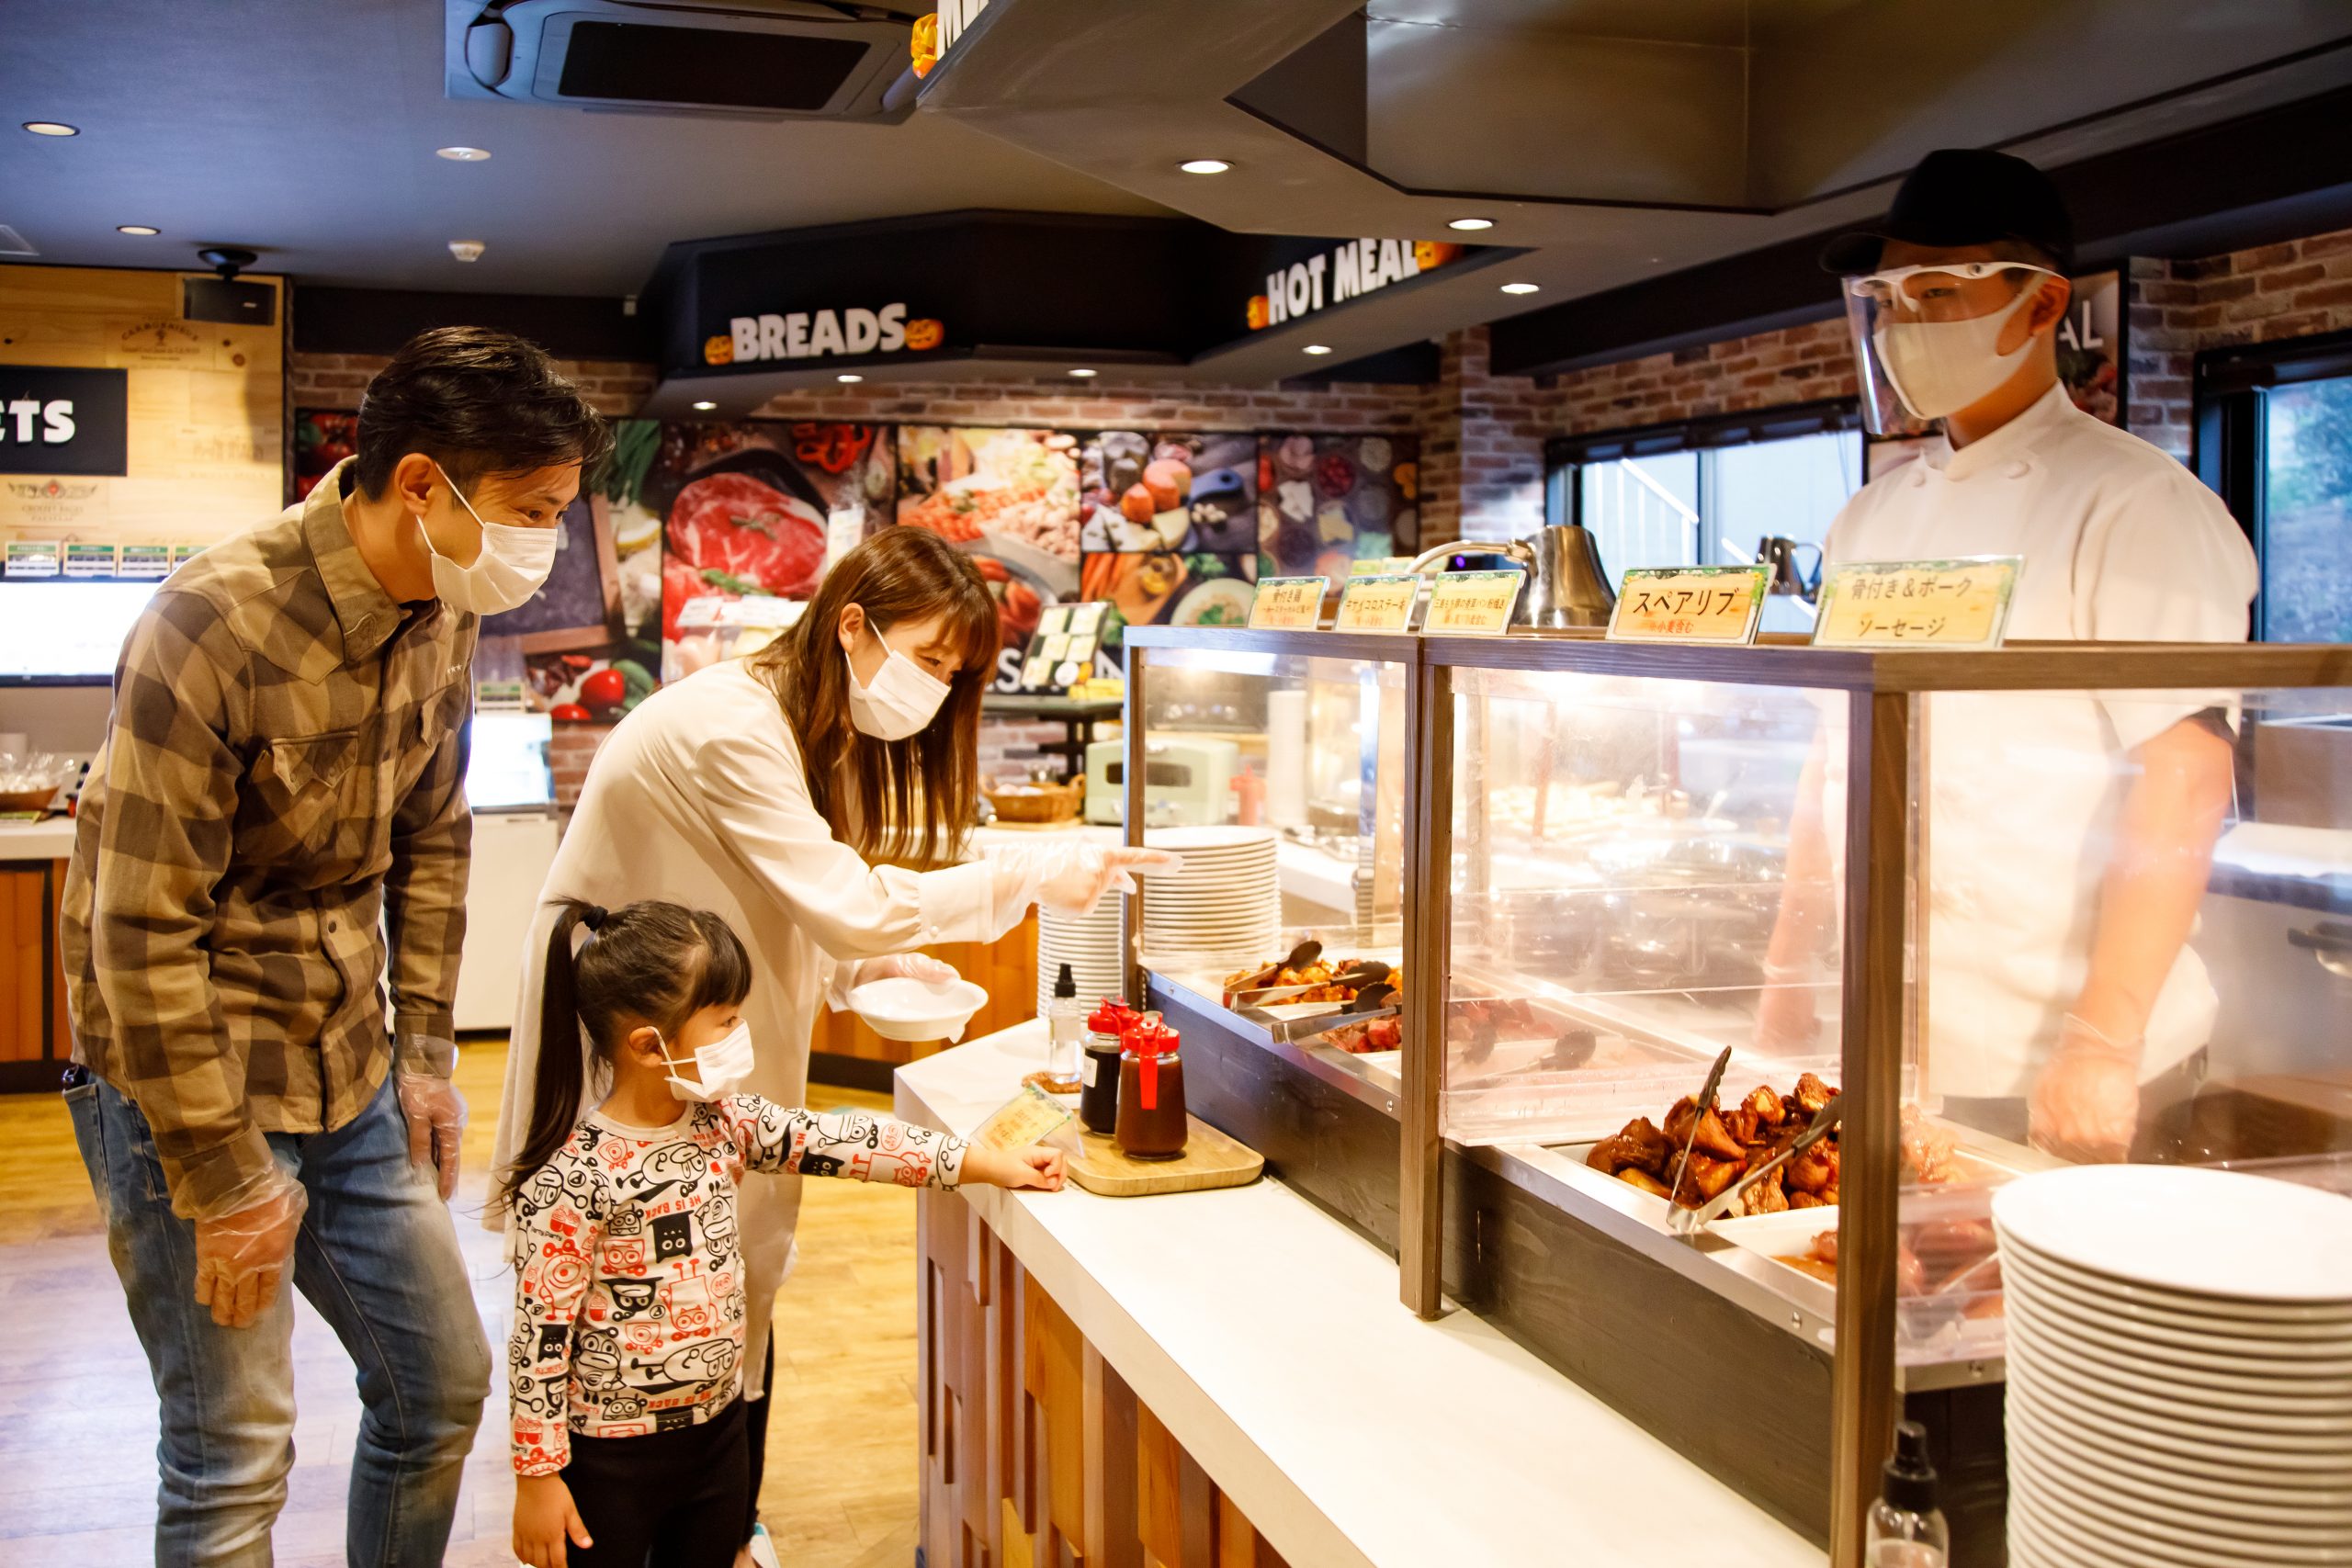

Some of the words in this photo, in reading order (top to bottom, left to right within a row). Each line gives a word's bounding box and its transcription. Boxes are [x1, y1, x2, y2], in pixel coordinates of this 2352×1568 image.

[1266, 253, 1326, 326] HOT
[1333, 238, 1420, 304] MEAL
[730, 302, 908, 363] BREADS
[0, 400, 76, 443] TS
[1633, 588, 1741, 616] スペアリブ
[1858, 617, 1947, 637] ソーセージ
[645, 1201, 670, 1220] BACK
[674, 1199, 685, 1211] IS
[689, 1195, 702, 1208] HE
